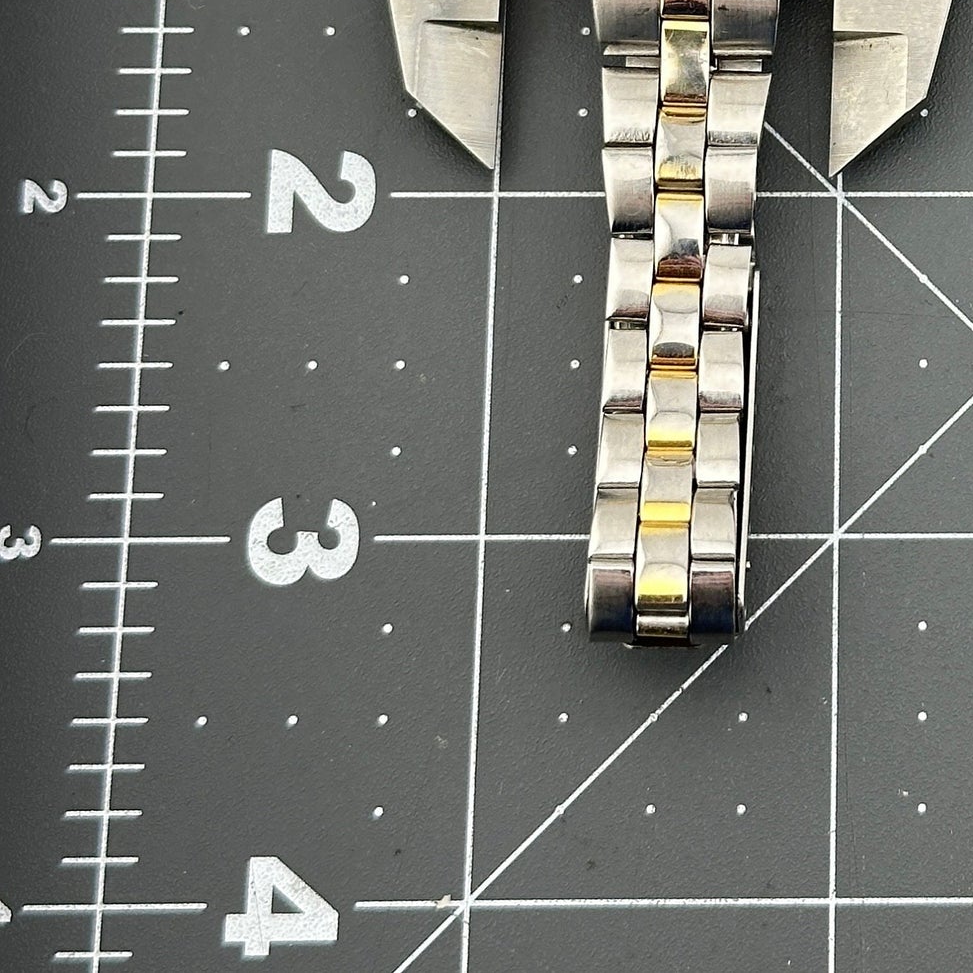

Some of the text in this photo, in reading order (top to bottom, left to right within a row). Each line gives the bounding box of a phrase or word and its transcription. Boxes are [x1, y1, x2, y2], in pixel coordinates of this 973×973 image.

[20, 179, 68, 214] 2
[266, 149, 377, 234] 2
[0, 524, 42, 561] 3
[247, 497, 361, 586] 3
[222, 856, 340, 957] 4
